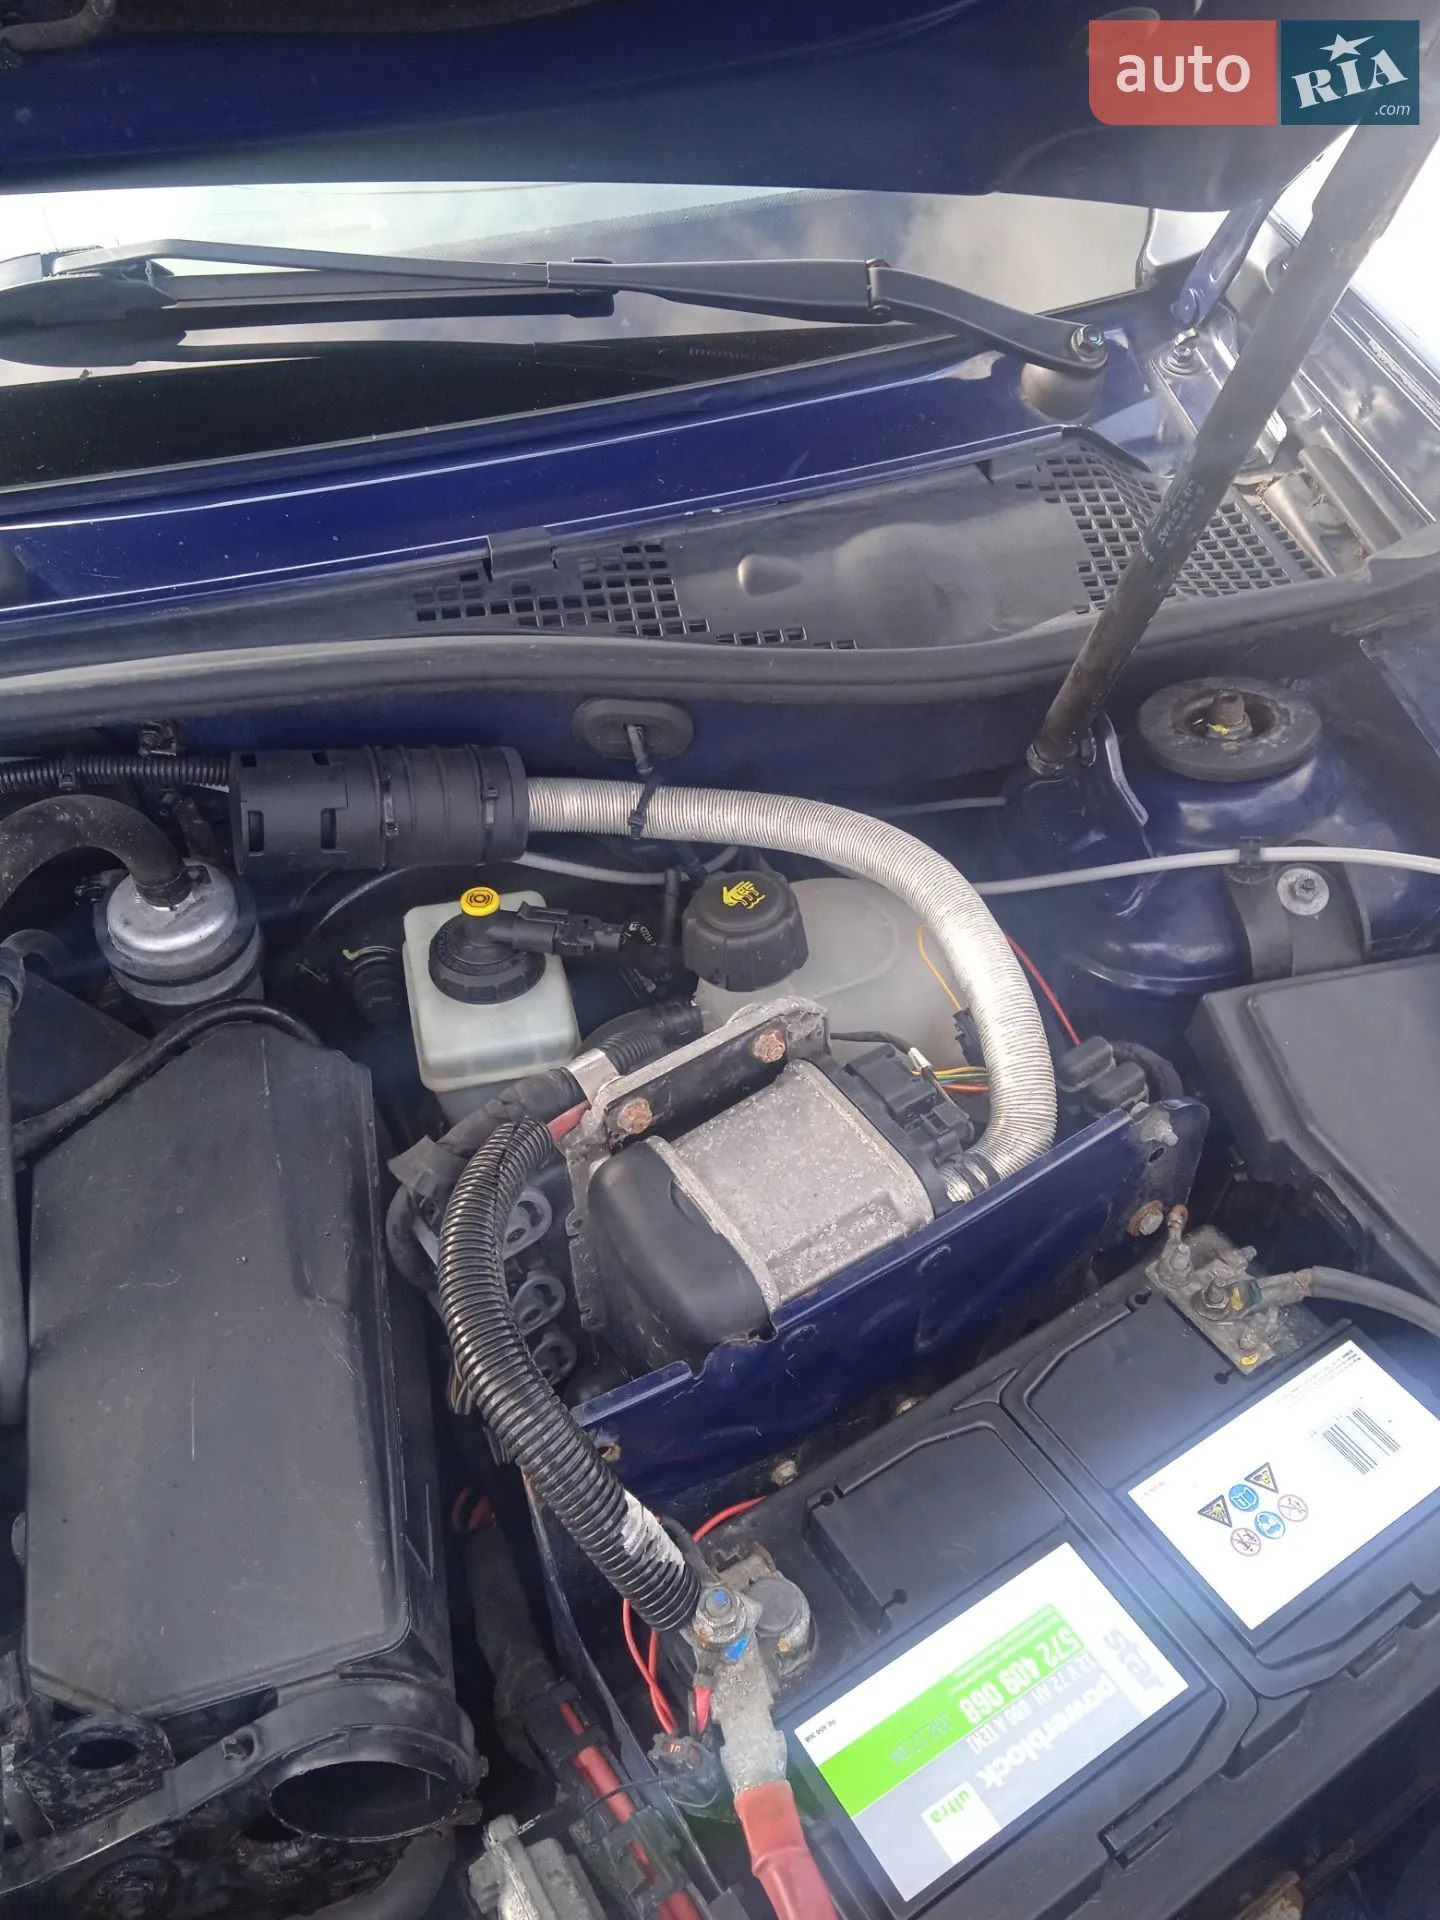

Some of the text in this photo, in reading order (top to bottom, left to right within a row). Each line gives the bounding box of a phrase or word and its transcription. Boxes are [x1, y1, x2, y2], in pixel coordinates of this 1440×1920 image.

[1035, 1627, 1081, 1667] 572
[997, 1656, 1041, 1695] 409
[959, 1681, 1005, 1724] 068
[975, 1672, 1118, 1789] powerblock
[930, 1789, 970, 1823] ultra
